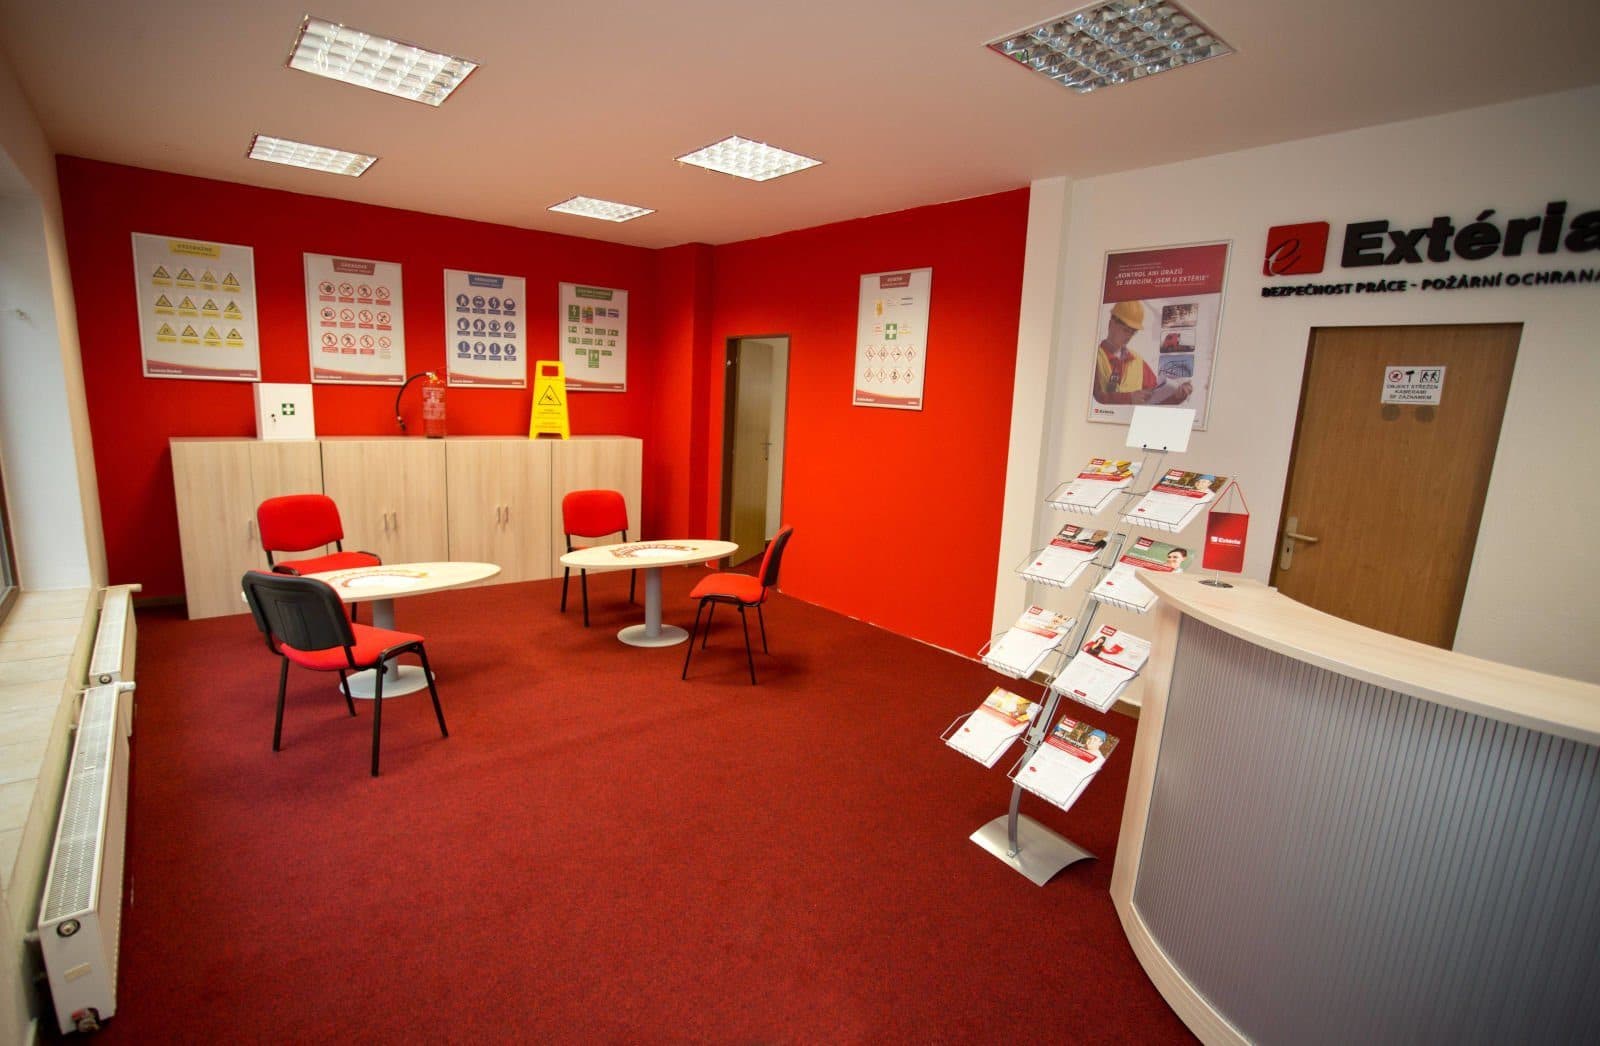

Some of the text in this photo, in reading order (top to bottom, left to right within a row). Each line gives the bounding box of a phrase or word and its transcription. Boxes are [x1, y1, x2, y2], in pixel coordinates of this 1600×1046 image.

[1341, 201, 1600, 268] Extéria
[1154, 276, 1171, 284] JSEM
[1261, 282, 1352, 298] BEZPEČNOST
[1355, 279, 1408, 294] PRÁCE
[1421, 271, 1503, 290] POŽÁRNÍ
